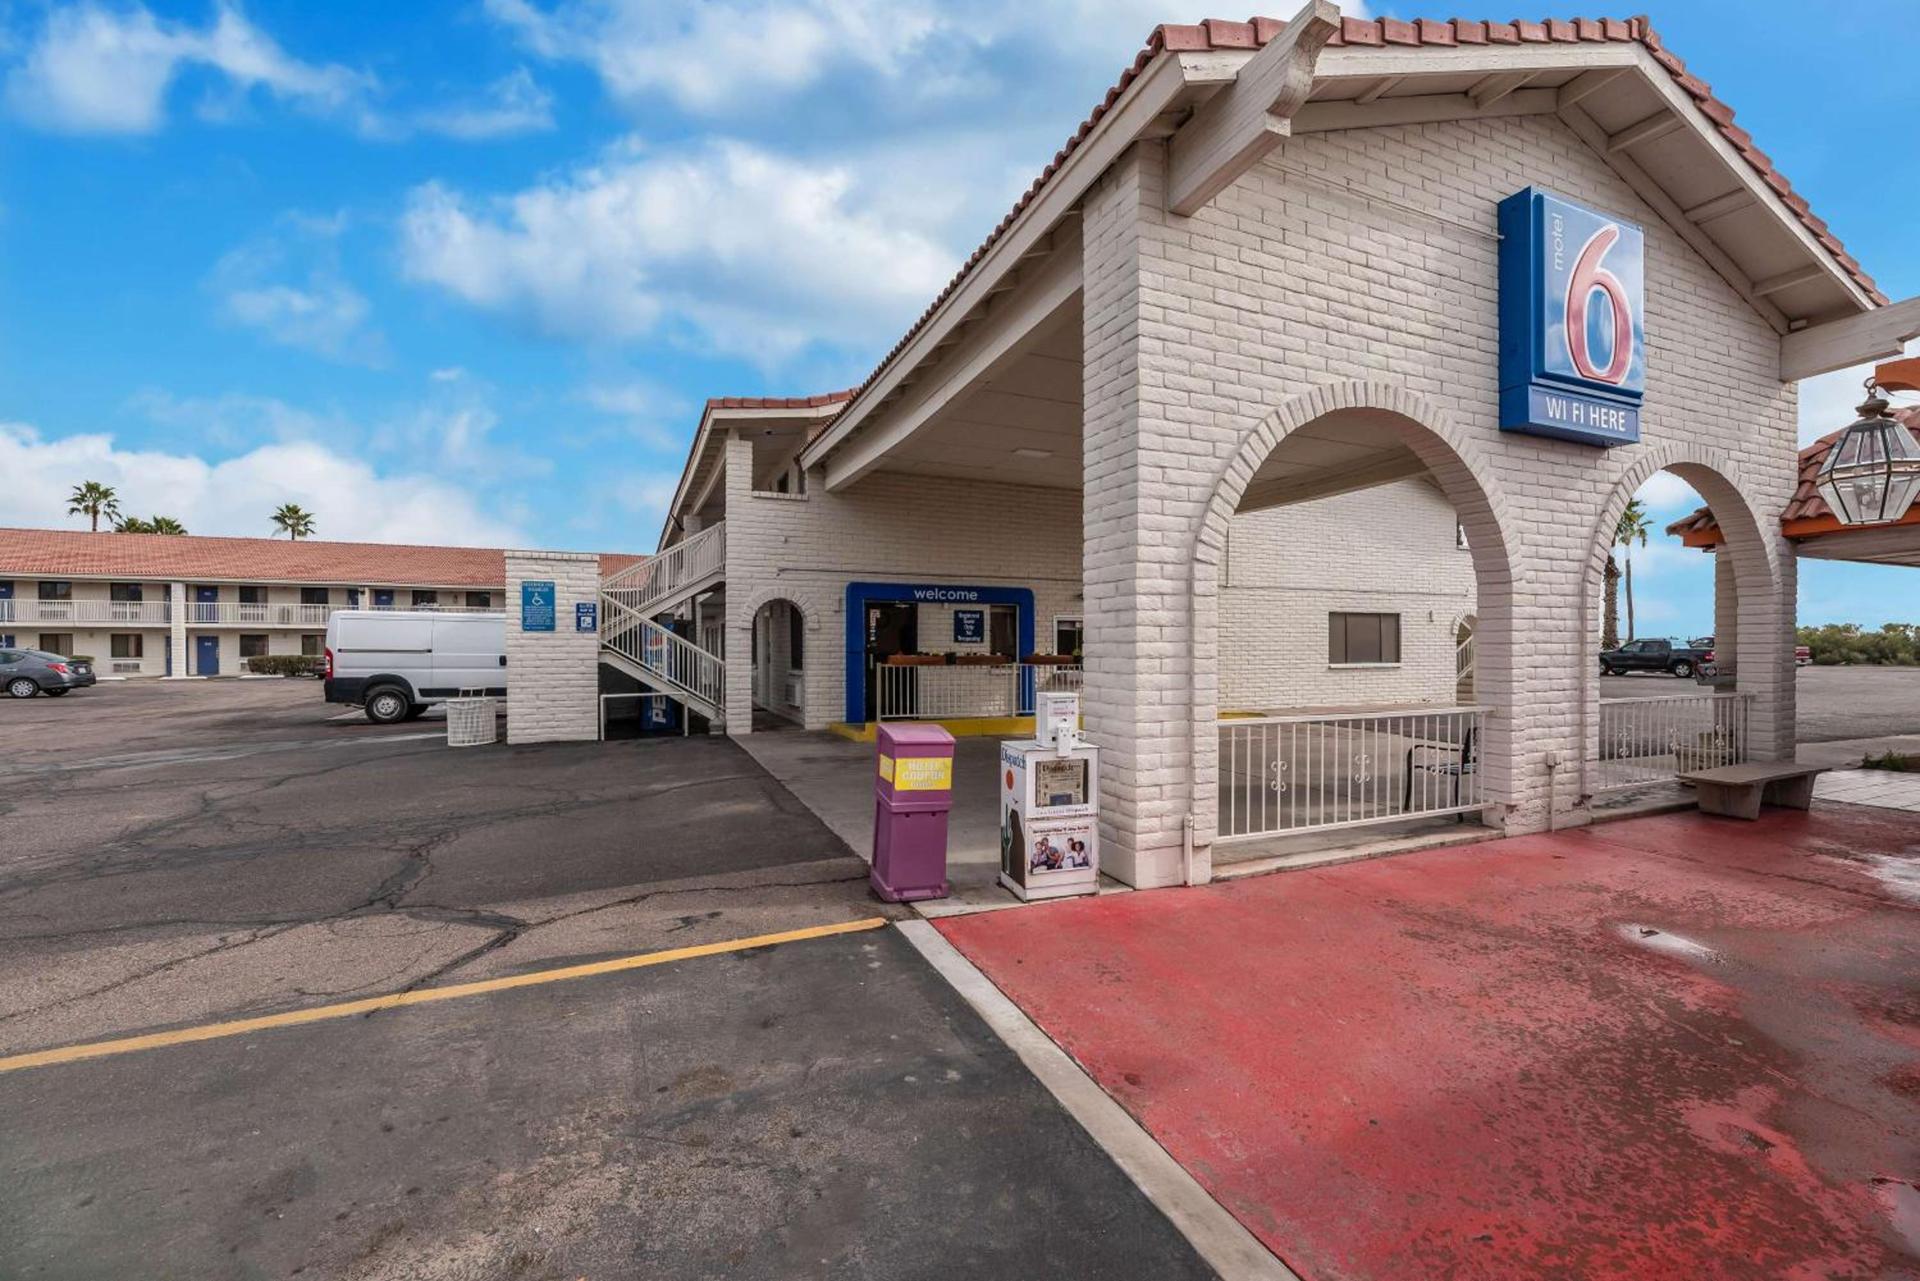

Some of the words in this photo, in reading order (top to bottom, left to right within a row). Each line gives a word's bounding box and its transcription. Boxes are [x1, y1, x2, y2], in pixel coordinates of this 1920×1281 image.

[1552, 212, 1565, 271] motel
[1563, 223, 1633, 385] 6
[1546, 396, 1566, 420] WI
[1573, 403, 1585, 425] FI
[1589, 406, 1626, 431] HERE
[914, 587, 978, 601] welcome
